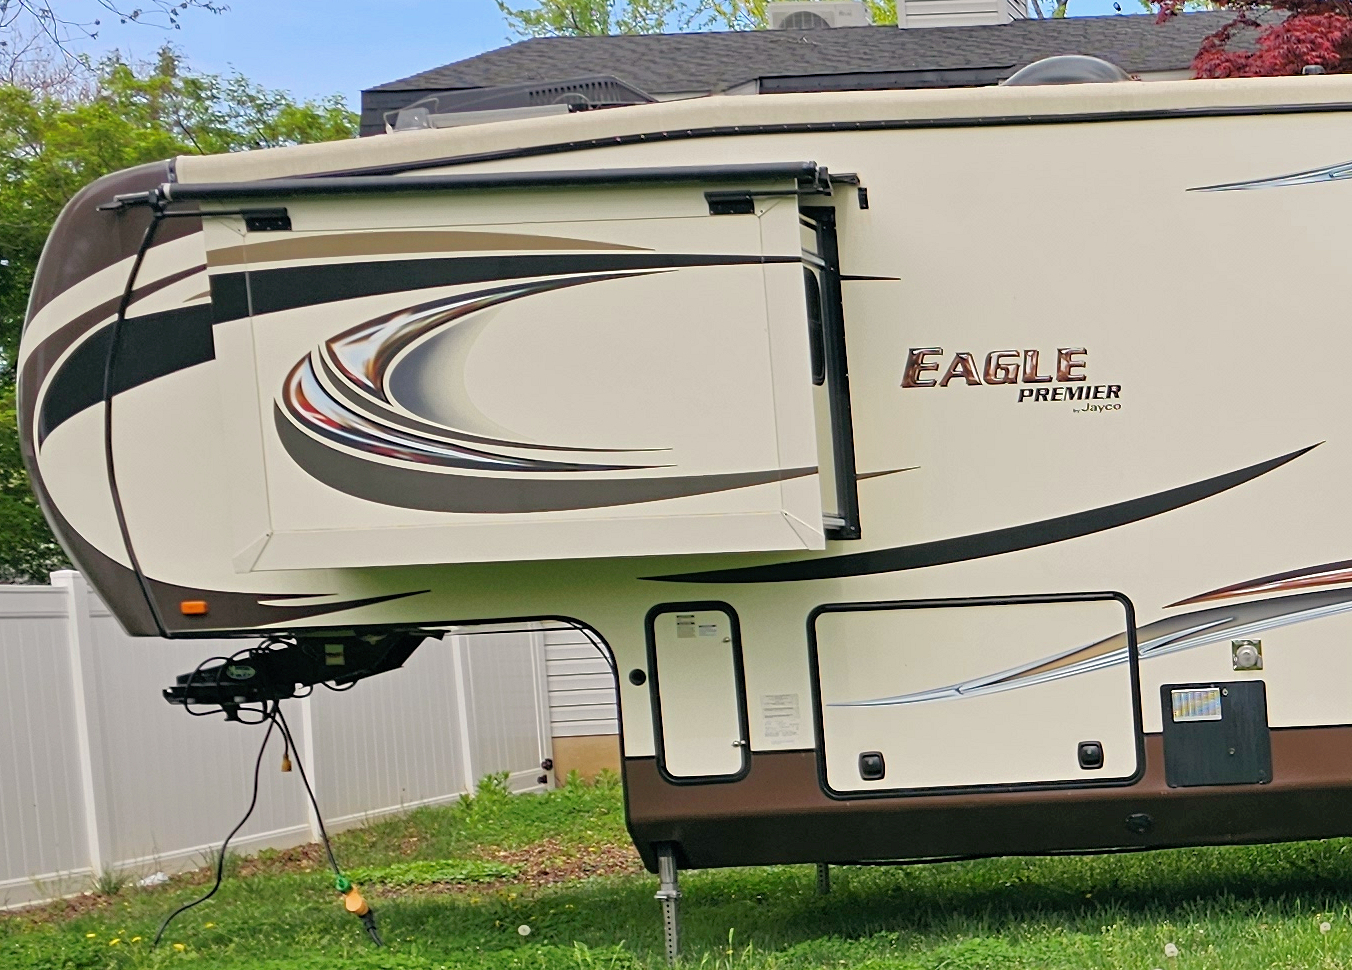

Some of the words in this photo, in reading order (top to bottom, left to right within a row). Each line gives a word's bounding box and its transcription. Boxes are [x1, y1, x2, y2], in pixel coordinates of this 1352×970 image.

[900, 346, 1088, 388] EAGLE
[1017, 384, 1122, 403] PREMIER
[1081, 402, 1122, 414] Jayco
